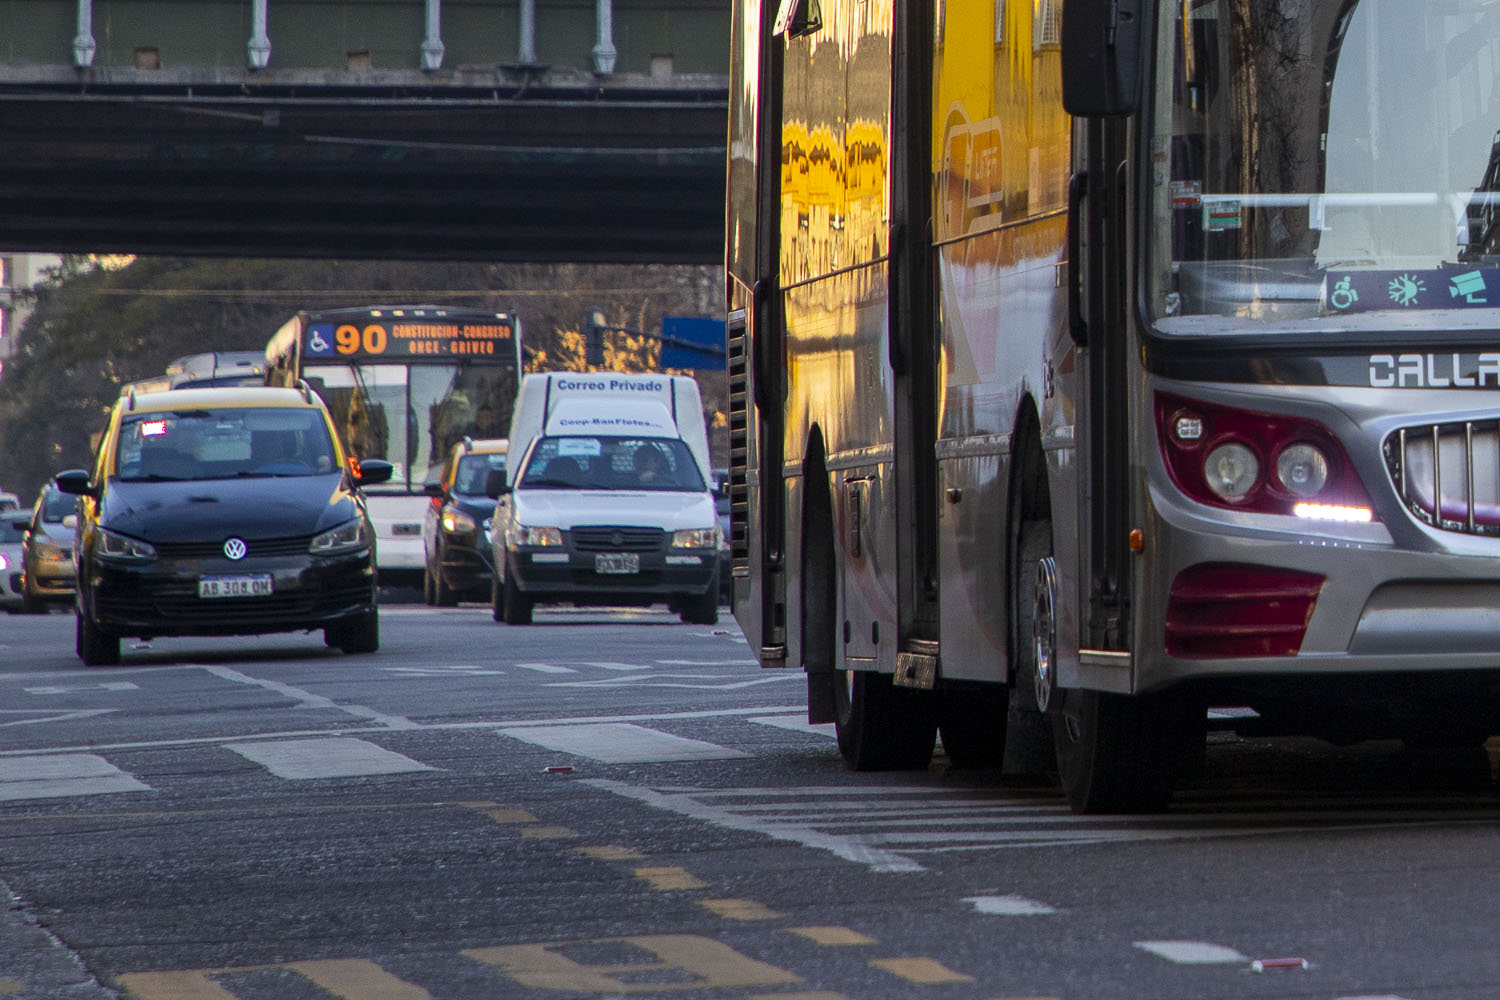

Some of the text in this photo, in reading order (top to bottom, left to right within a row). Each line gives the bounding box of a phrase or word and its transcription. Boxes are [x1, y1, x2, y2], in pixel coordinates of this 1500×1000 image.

[335, 324, 388, 355] 90
[409, 341, 440, 354] ONCE
[557, 379, 663, 392] Correo Privado
[202, 582, 219, 596] AB
[221, 582, 248, 595] 308
